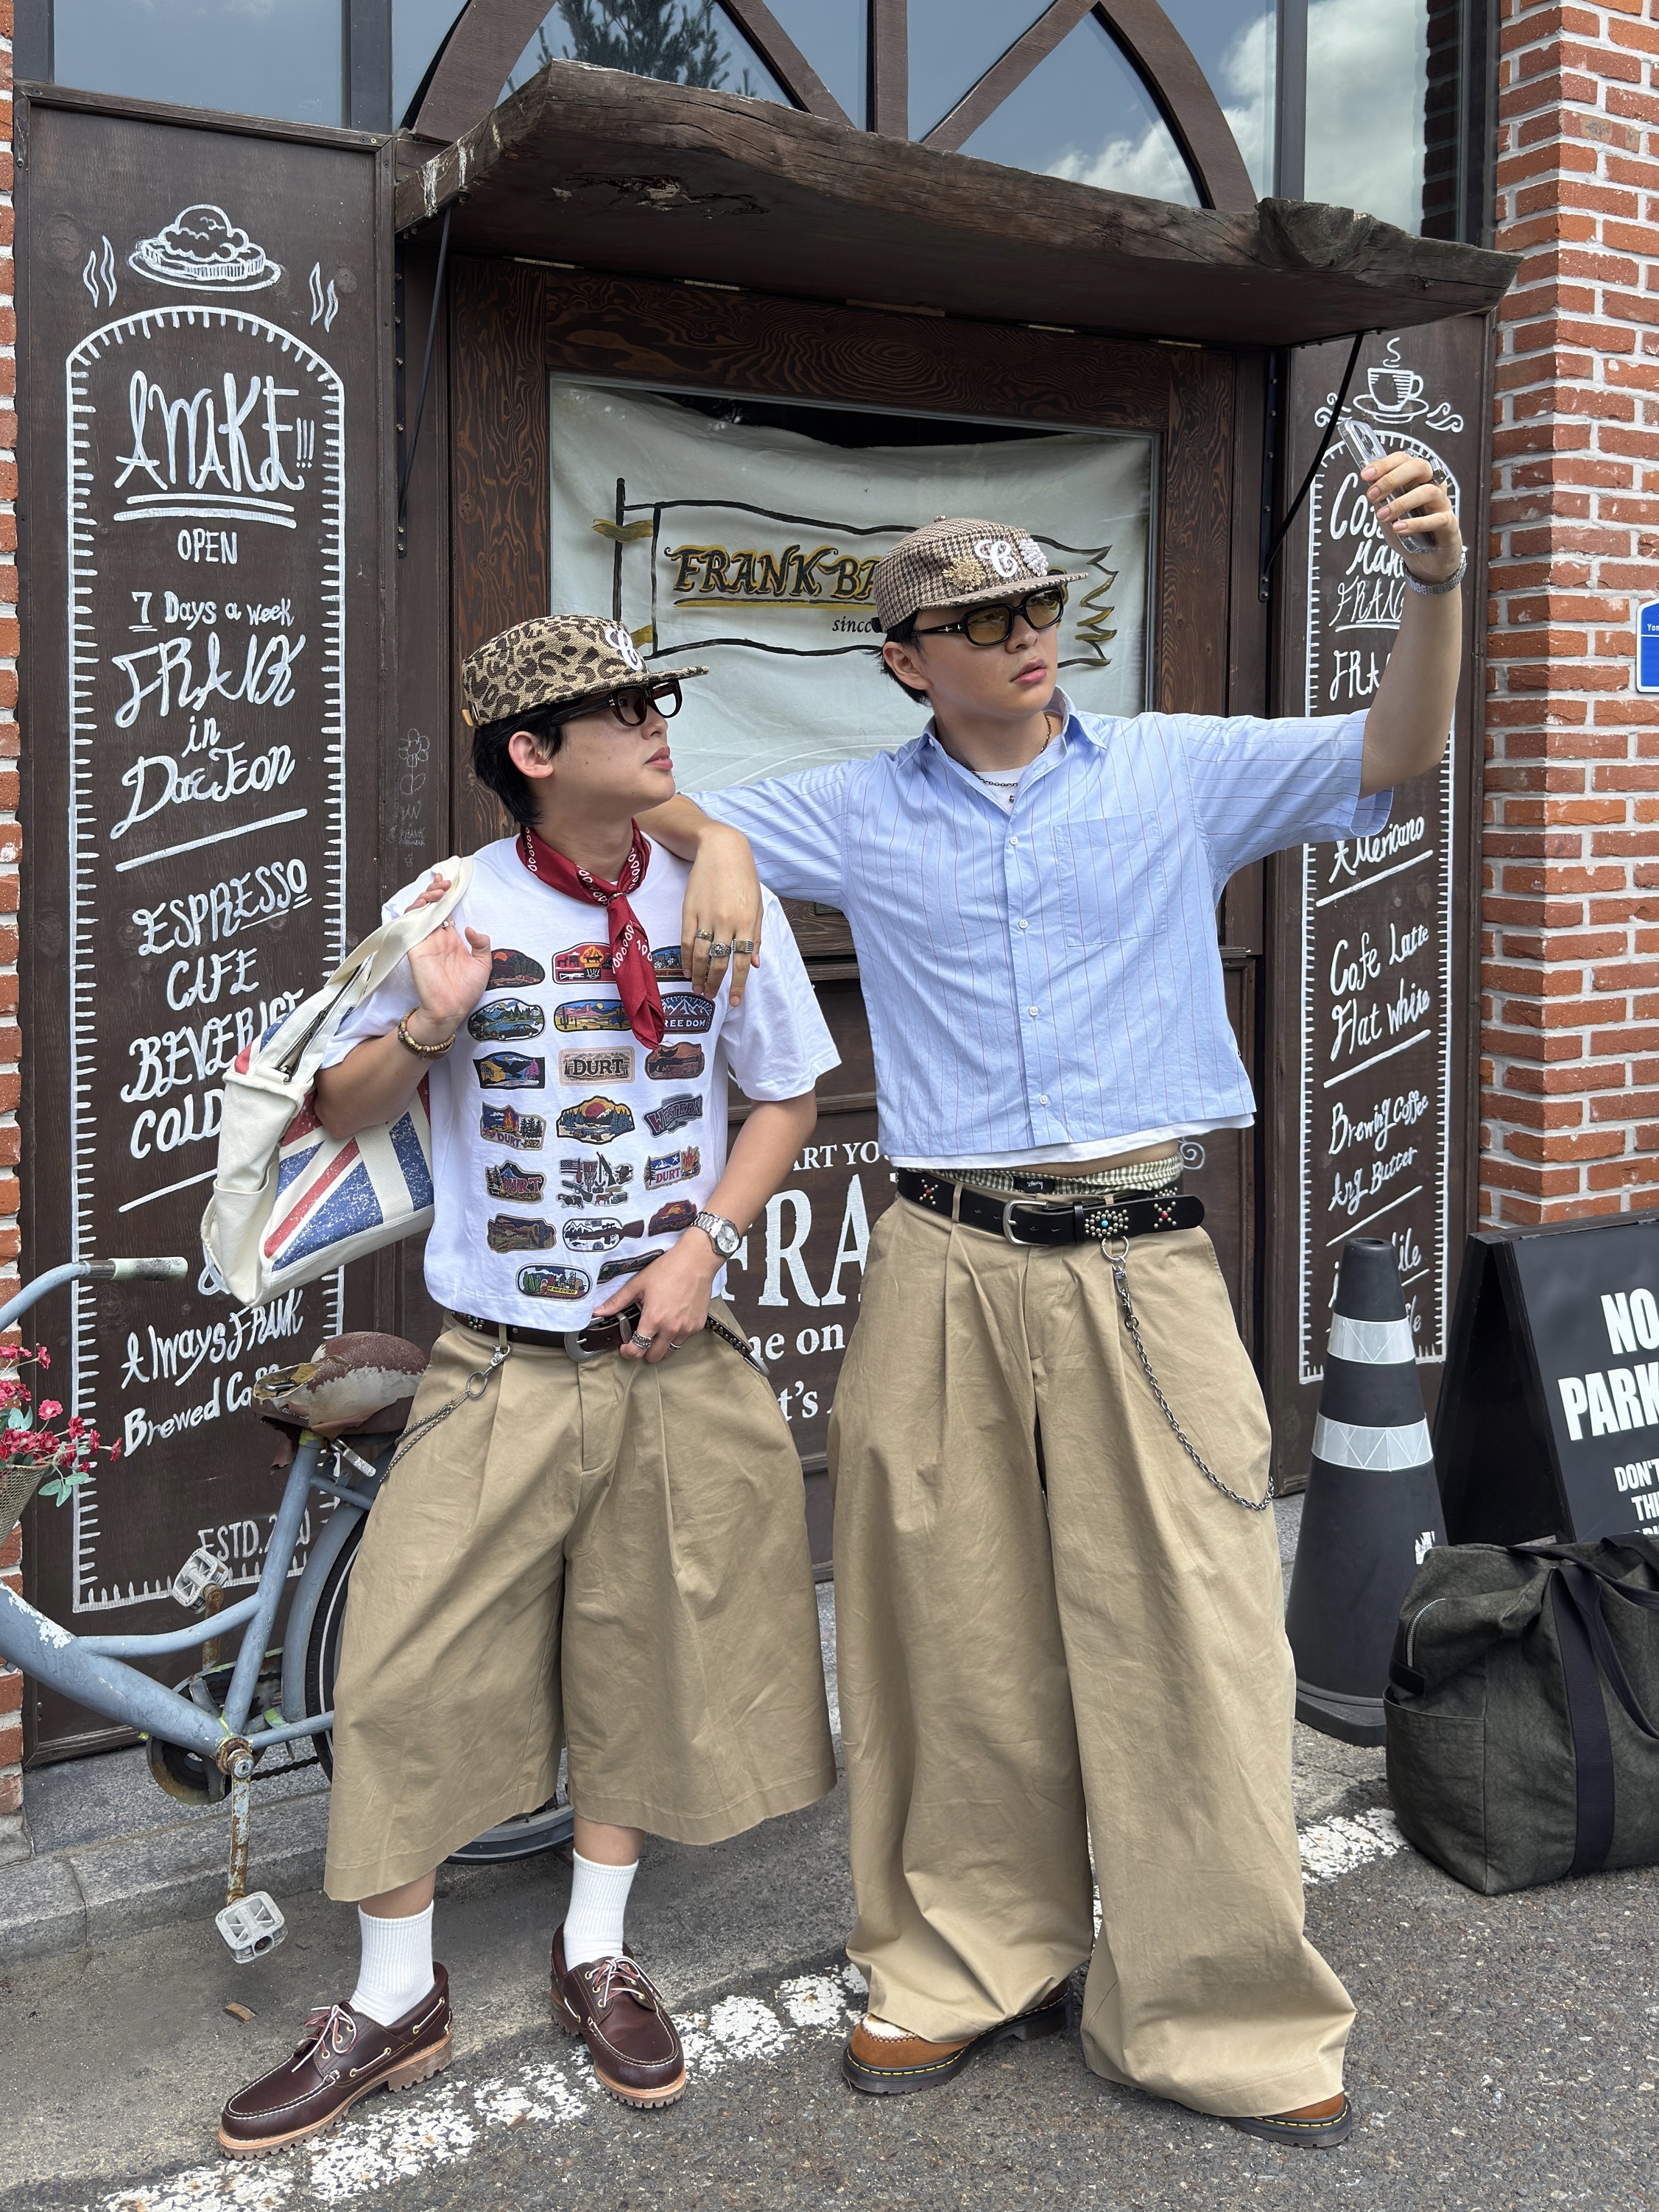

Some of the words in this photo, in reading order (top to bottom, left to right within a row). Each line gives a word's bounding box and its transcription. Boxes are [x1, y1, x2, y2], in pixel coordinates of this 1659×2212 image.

[177, 529, 237, 565] OPEN
[663, 543, 839, 598] FRANK
[131, 591, 153, 624] 7
[164, 591, 217, 631] Days
[225, 602, 242, 621] a
[1329, 649, 1392, 702] FRA
[182, 715, 221, 757] in
[133, 858, 309, 957] ESPRESSO
[1389, 923, 1429, 965] Latte
[166, 948, 259, 1012] CAFE
[1330, 998, 1383, 1062] Flat
[573, 1058, 624, 1077] DURT
[646, 1096, 702, 1133] WESTERN
[1328, 1097, 1398, 1155] Brewing
[1392, 1089, 1429, 1126] Coffee
[496, 1133, 522, 1148] DURT
[502, 1176, 543, 1194] DURT
[655, 1166, 682, 1184] DURT
[1369, 1146, 1418, 1195] Butter
[795, 1323, 846, 1356] on
[1600, 1287, 1659, 1356] NO
[121, 1322, 226, 1389] Always
[123, 1376, 221, 1457] Brewed
[1630, 1490, 1659, 1522] THI
